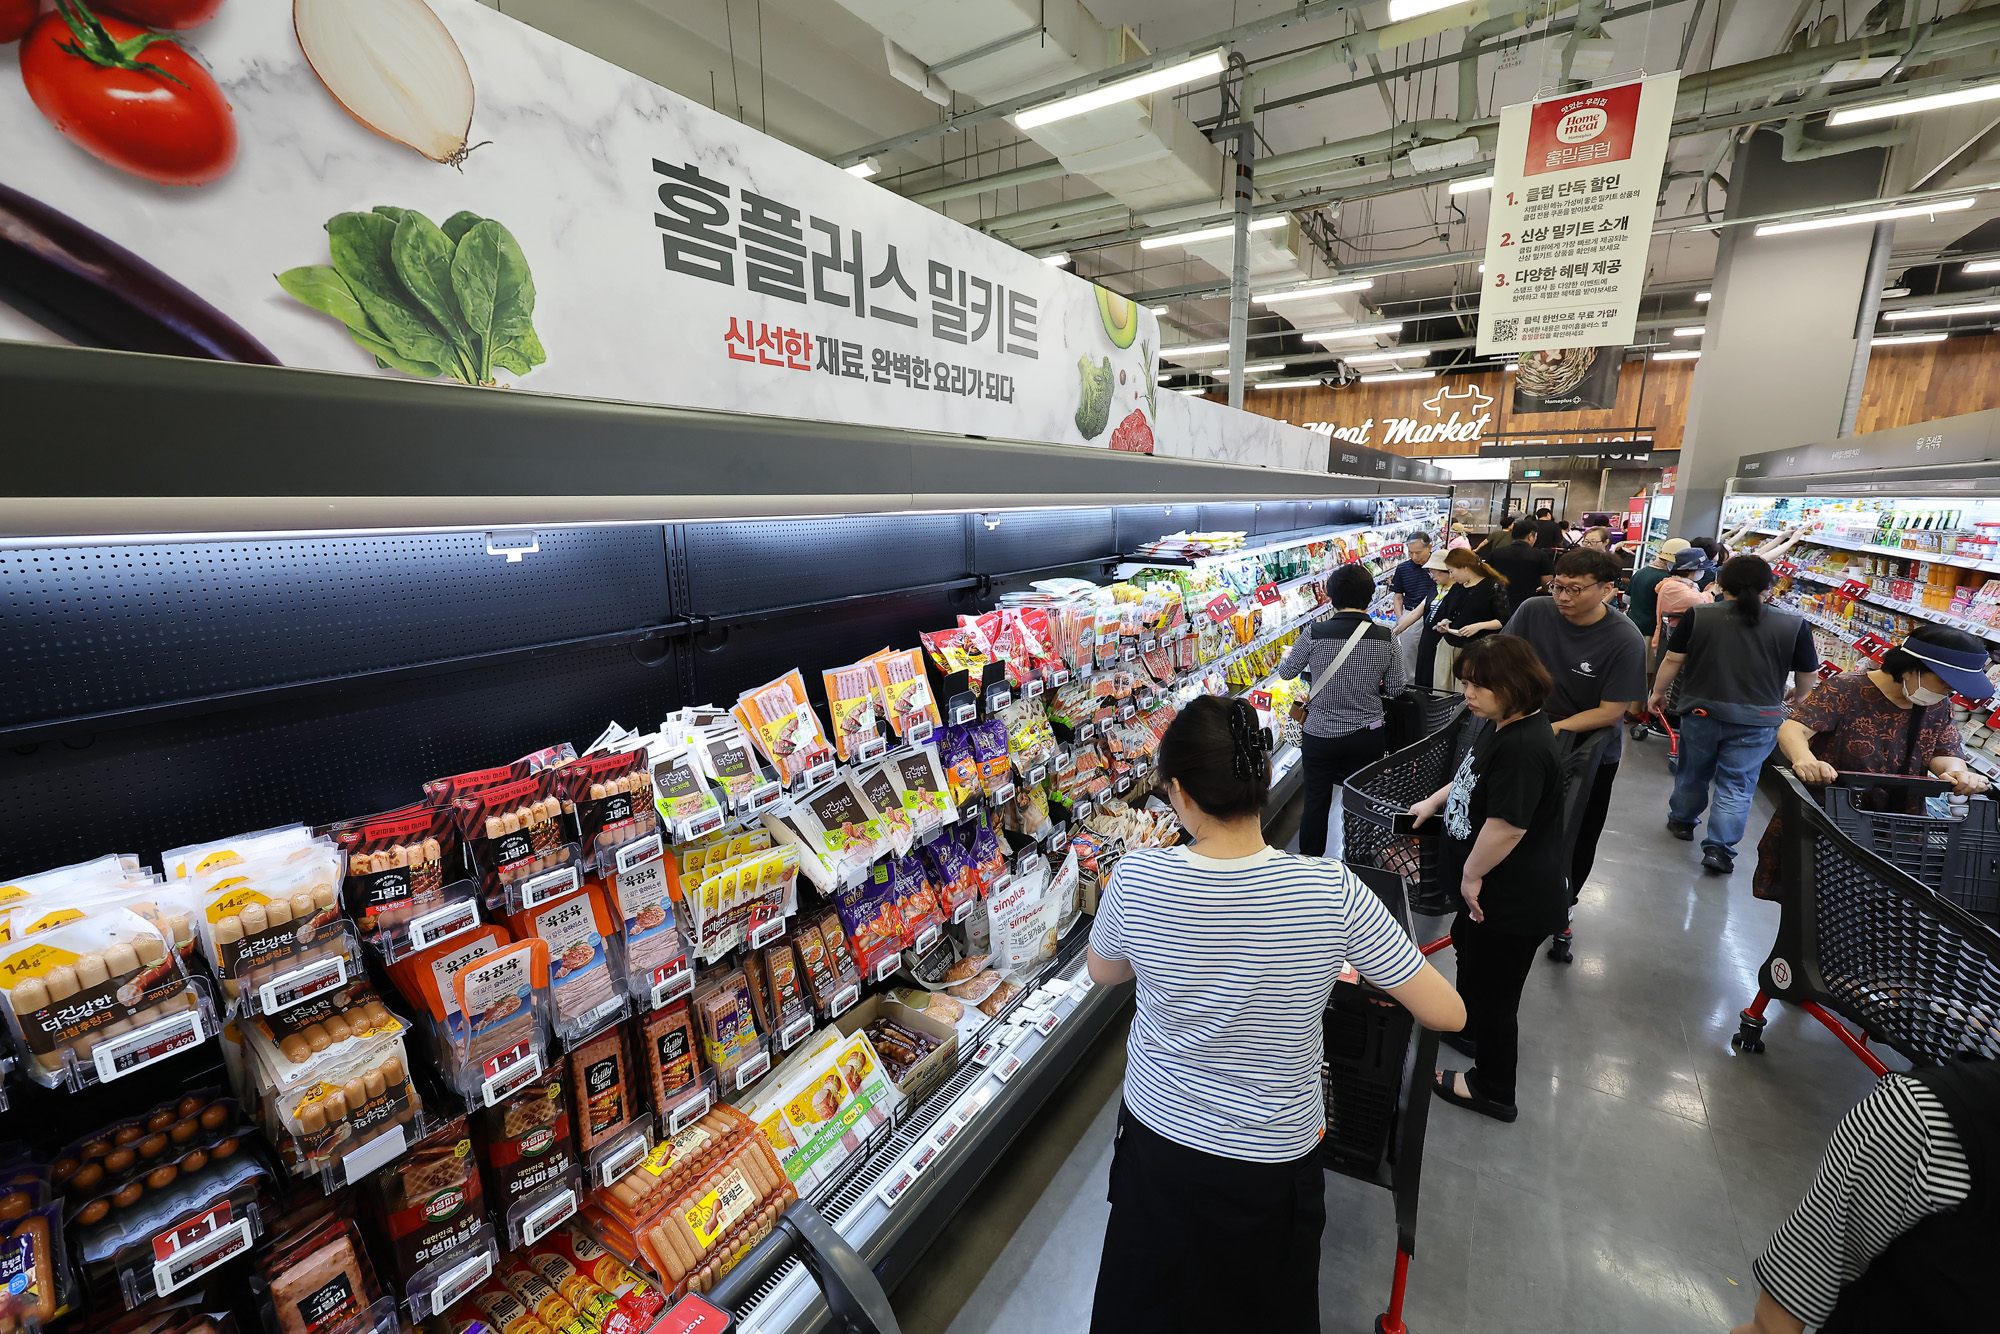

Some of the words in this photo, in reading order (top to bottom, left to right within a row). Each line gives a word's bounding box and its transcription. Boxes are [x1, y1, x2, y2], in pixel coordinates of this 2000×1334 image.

[1561, 101, 1584, 114] 맛있는
[1586, 97, 1608, 107] 우리집
[1565, 121, 1598, 134] meal
[1566, 113, 1600, 125] Home
[1545, 141, 1611, 167] 홈밀클럽
[1507, 192, 1518, 206] 1.
[1527, 184, 1554, 202] 클럽
[1558, 179, 1586, 197] 단독
[1591, 174, 1620, 193] 할인
[1599, 193, 1618, 202] 밀키트
[1619, 189, 1640, 199] 상품의
[1537, 211, 1549, 219] 전용
[1550, 209, 1569, 217] 쿠폰을
[1571, 204, 1603, 214] 받아보세요
[1500, 233, 1515, 247] 2.
[1521, 227, 1549, 243] 신상
[1552, 221, 1594, 240] 밀키트
[1598, 215, 1629, 232] 소개
[1519, 246, 1531, 254] 클럽
[1534, 243, 1560, 252] 회원에게
[1562, 240, 1575, 249] 가장
[1600, 235, 1628, 245] 제공되는
[652, 157, 917, 328] 홈플러스
[928, 259, 1038, 359] 밀키트
[1518, 254, 1531, 262] 신상
[1533, 251, 1552, 260] 밀키트
[1495, 274, 1509, 287] 3.
[1515, 267, 1557, 283] 다양한
[1559, 262, 1588, 279] 혜택
[1591, 259, 1622, 275] 제공
[1512, 293, 1538, 302] 참여하고
[1540, 291, 1560, 299] 특별한
[1583, 286, 1618, 295] 받아보세요
[1558, 281, 1578, 290] 다양한
[1580, 278, 1608, 287] 이벤트에
[1524, 315, 1540, 324] 클릭
[1542, 312, 1575, 323] 한번으로
[1578, 310, 1594, 320] 무료
[1597, 308, 1617, 318] 가입!
[1522, 324, 1540, 333] 자세한
[1542, 324, 1560, 332] 내용은
[1553, 330, 1584, 338] 확인하세요
[724, 316, 813, 371] 신선한
[817, 335, 869, 383] 재료,
[871, 348, 931, 391] 완벽한
[934, 360, 983, 399] 요리가
[985, 372, 1014, 405] 되다
[1382, 412, 1491, 445] Market
[1776, 564, 1794, 575] 1+1
[1258, 586, 1277, 600] 1+1
[1842, 583, 1864, 596] 1+1
[1210, 598, 1232, 616] 1+1
[1860, 636, 1882, 653] 1+1
[1253, 694, 1270, 706] 1+1
[717, 751, 744, 766] 더건강한
[660, 769, 690, 787] 더건강한
[905, 764, 928, 780] 더건강한
[869, 783, 891, 803] 더건강한
[606, 806, 630, 821] 그릴리
[821, 795, 853, 820] 더건강한
[499, 843, 529, 863] 그릴리
[624, 868, 657, 887] 육공육
[370, 884, 407, 902] 그릴리
[993, 886, 1026, 913] simplus
[545, 904, 583, 927] 육공육
[1009, 904, 1046, 929] simplus
[240, 932, 294, 959] 더건강한
[475, 958, 521, 983] 육공육
[41, 994, 112, 1032] 더건강한
[283, 1000, 331, 1024] 더건강한
[56, 1011, 114, 1042] 그릴후랑크
[663, 1035, 684, 1054] Grilly
[490, 1045, 522, 1073] 1+1
[590, 1066, 615, 1085] Grilly
[520, 1130, 553, 1150] 의성마늘
[510, 1157, 570, 1194] 의성마늘햄
[518, 1162, 544, 1177] 대한민국
[716, 1171, 741, 1197] 오리지널
[425, 1193, 463, 1216] 의성마늘
[721, 1183, 744, 1207] 후랑크
[165, 1212, 218, 1252] 1+1
[415, 1218, 482, 1263] 의성마늘햄
[423, 1226, 454, 1246] 대한민국
[310, 1288, 346, 1320] 그릴리
